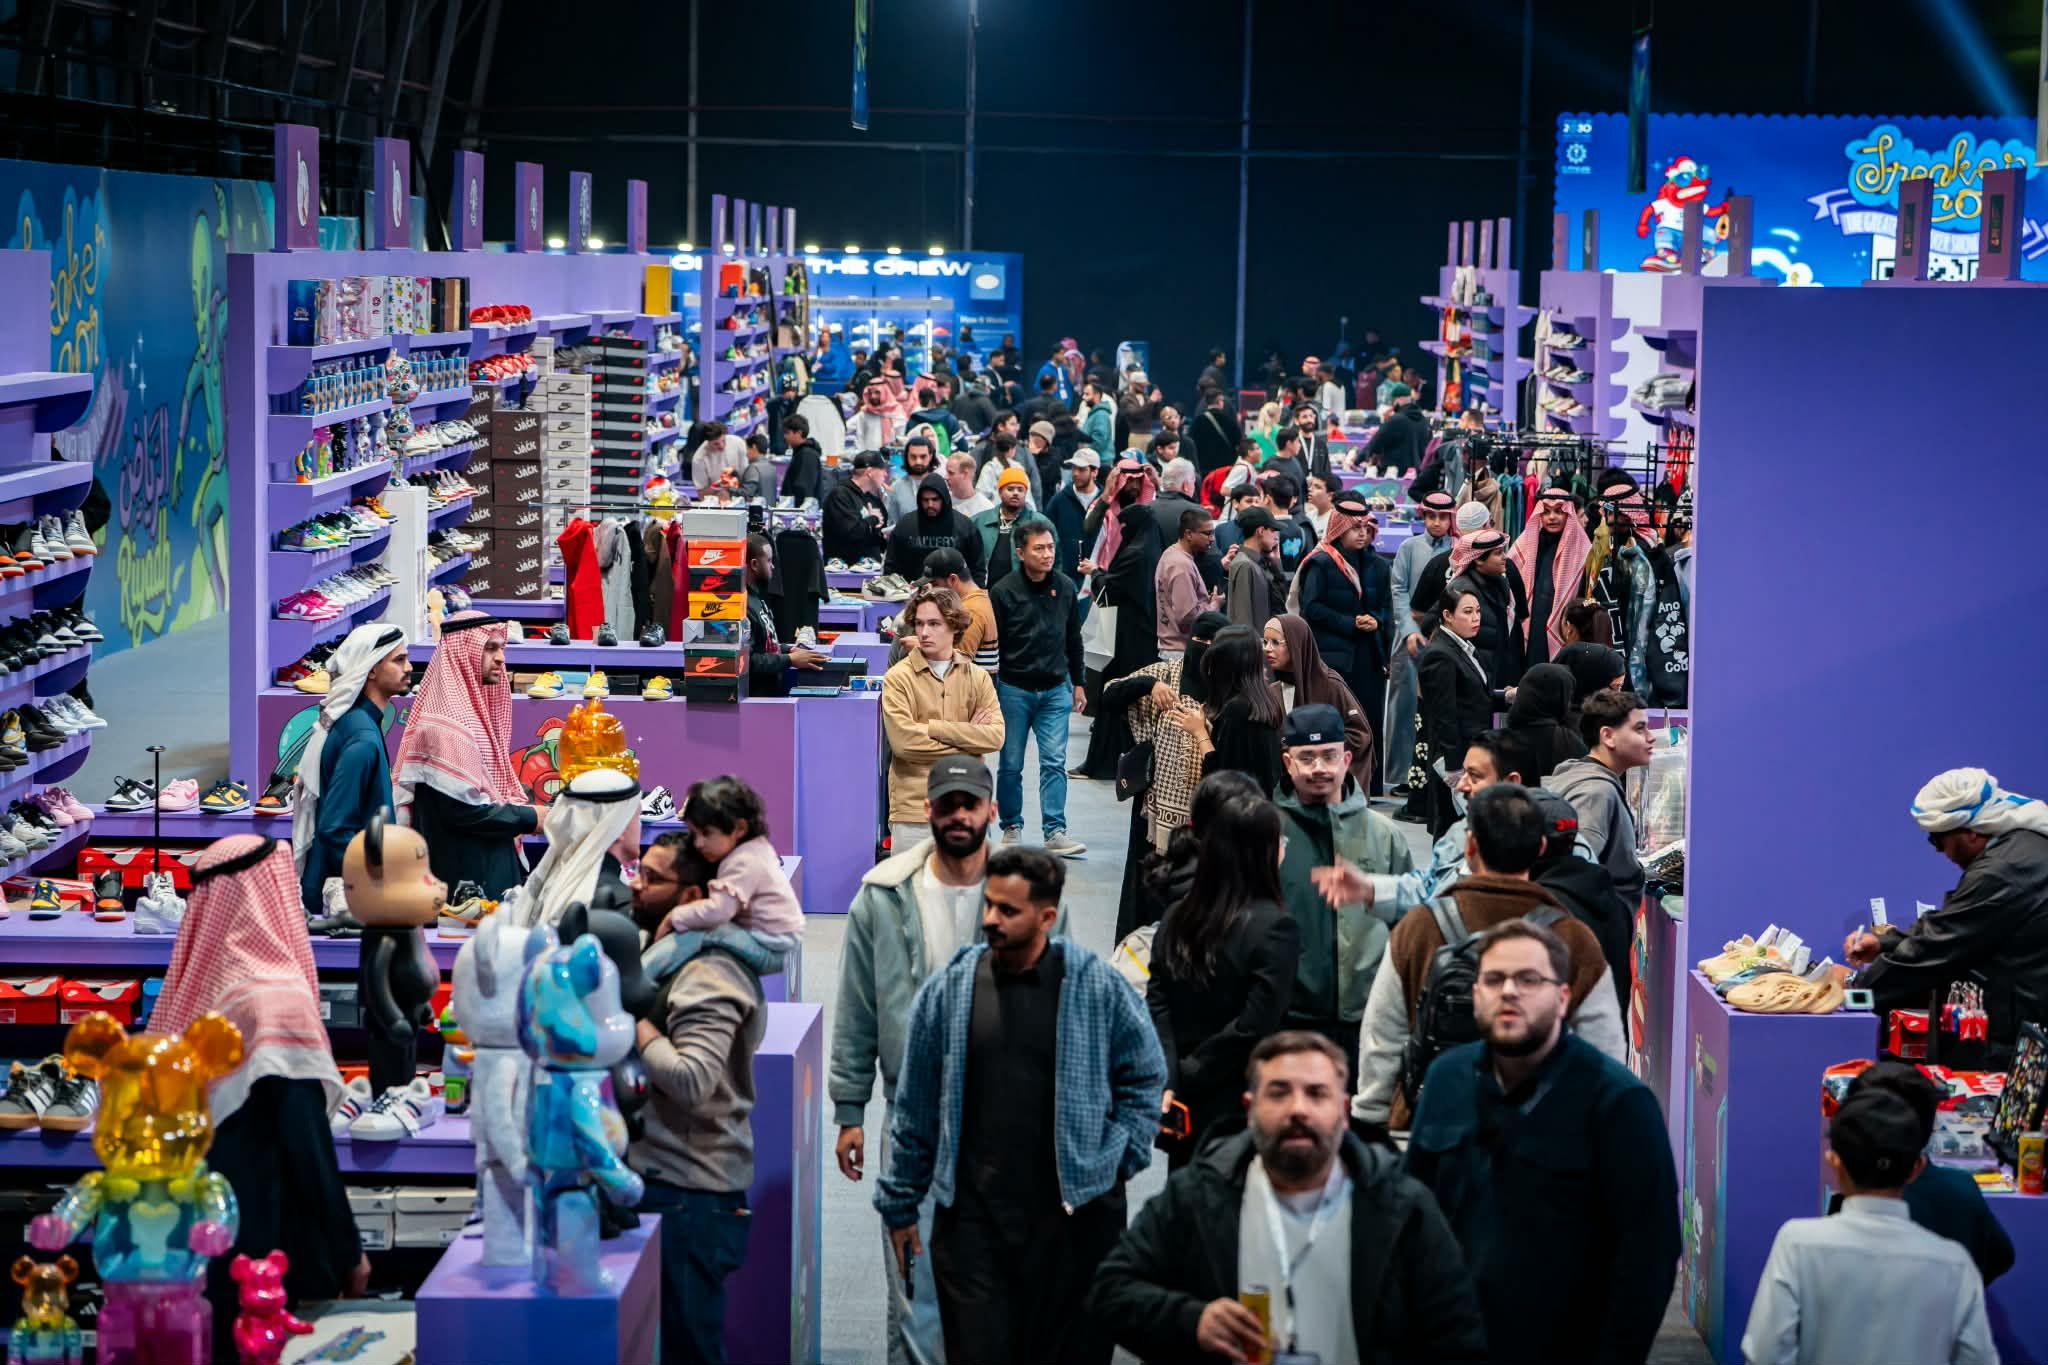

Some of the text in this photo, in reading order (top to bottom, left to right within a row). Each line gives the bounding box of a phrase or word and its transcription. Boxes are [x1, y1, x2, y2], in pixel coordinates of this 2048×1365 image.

[805, 258, 869, 275] THE
[873, 259, 971, 277] CREW
[513, 417, 538, 432] JACK
[513, 440, 538, 455] JACK
[514, 464, 539, 479] JACK
[515, 487, 540, 502] JACK
[515, 511, 540, 526] JACK
[515, 534, 540, 550] JACK
[515, 558, 540, 573] JACK
[117, 506, 172, 649] Riyadh
[514, 582, 539, 597] JACK
[704, 601, 724, 611] NIKE
[1658, 601, 1681, 614] Ano
